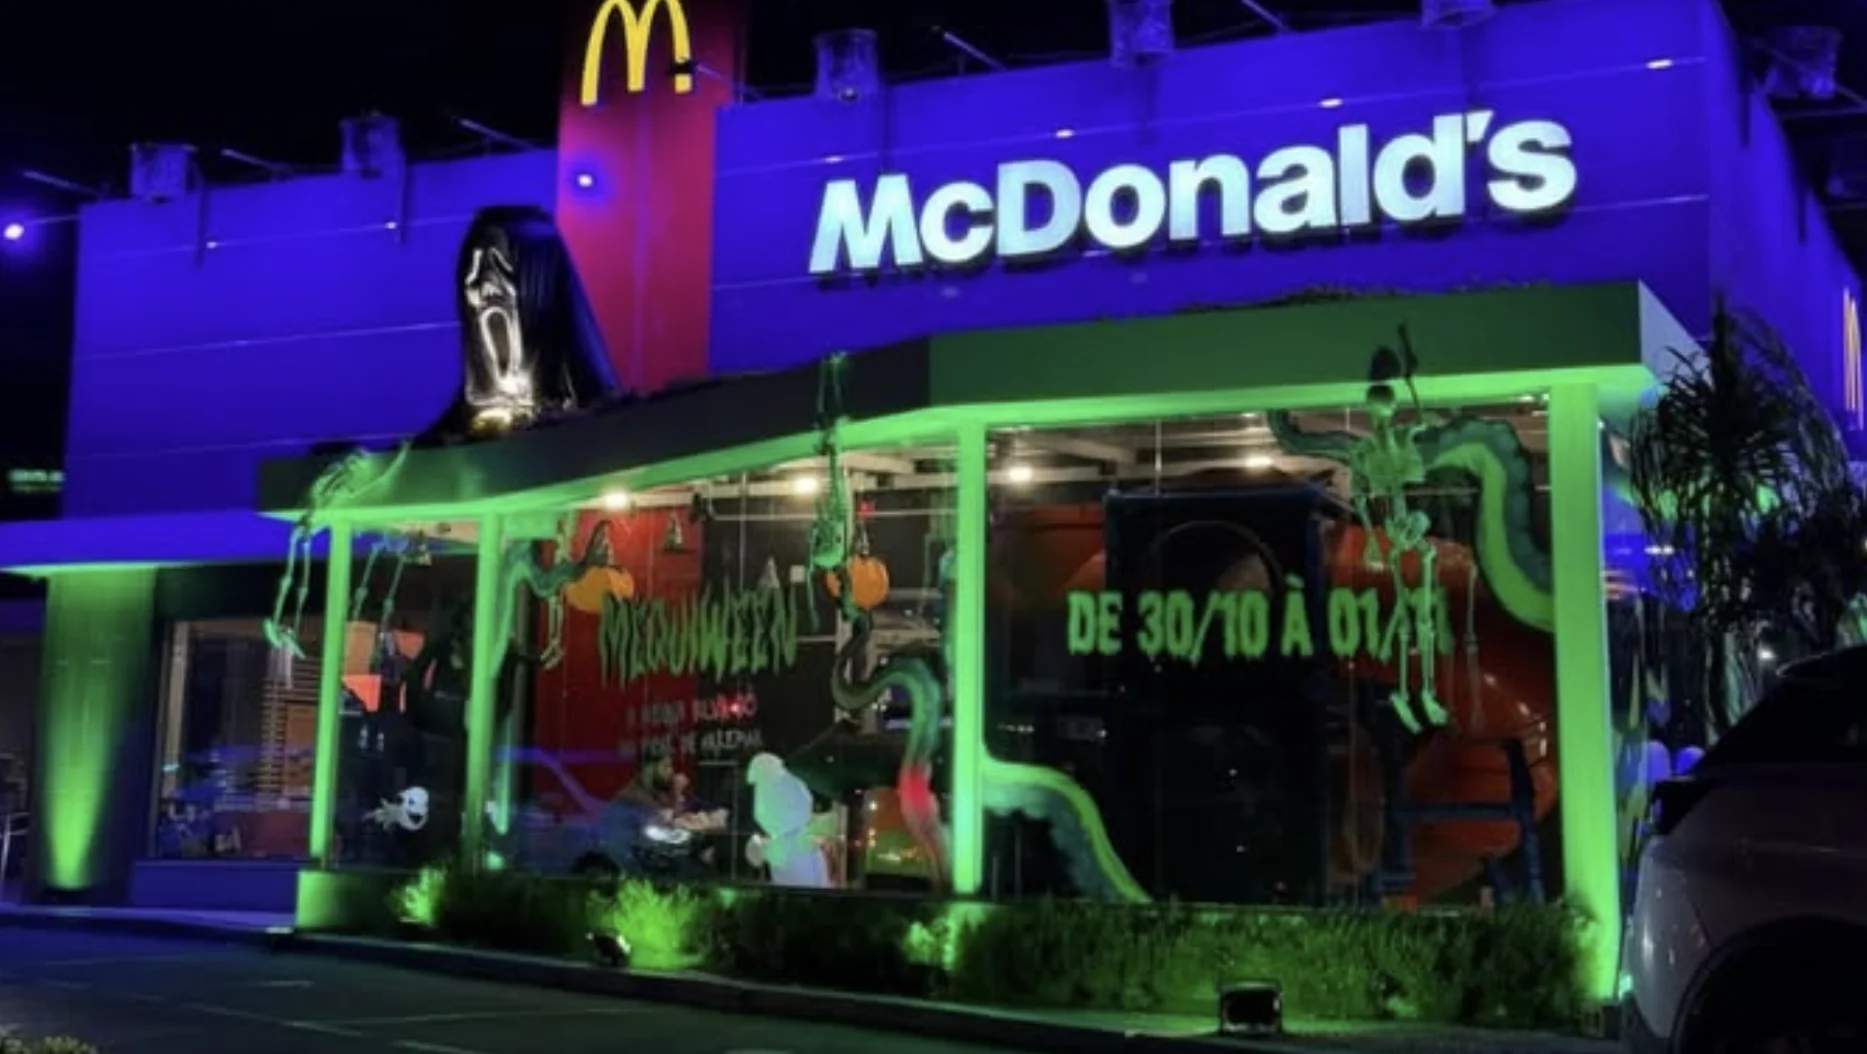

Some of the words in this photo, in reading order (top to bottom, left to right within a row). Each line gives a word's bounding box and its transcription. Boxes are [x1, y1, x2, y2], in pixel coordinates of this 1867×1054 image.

[808, 110, 1578, 274] McDonald's
[1067, 591, 1124, 657] DE
[1136, 590, 1270, 667] 30/10
[1280, 573, 1315, 657] À
[1327, 586, 1454, 667] 01/11
